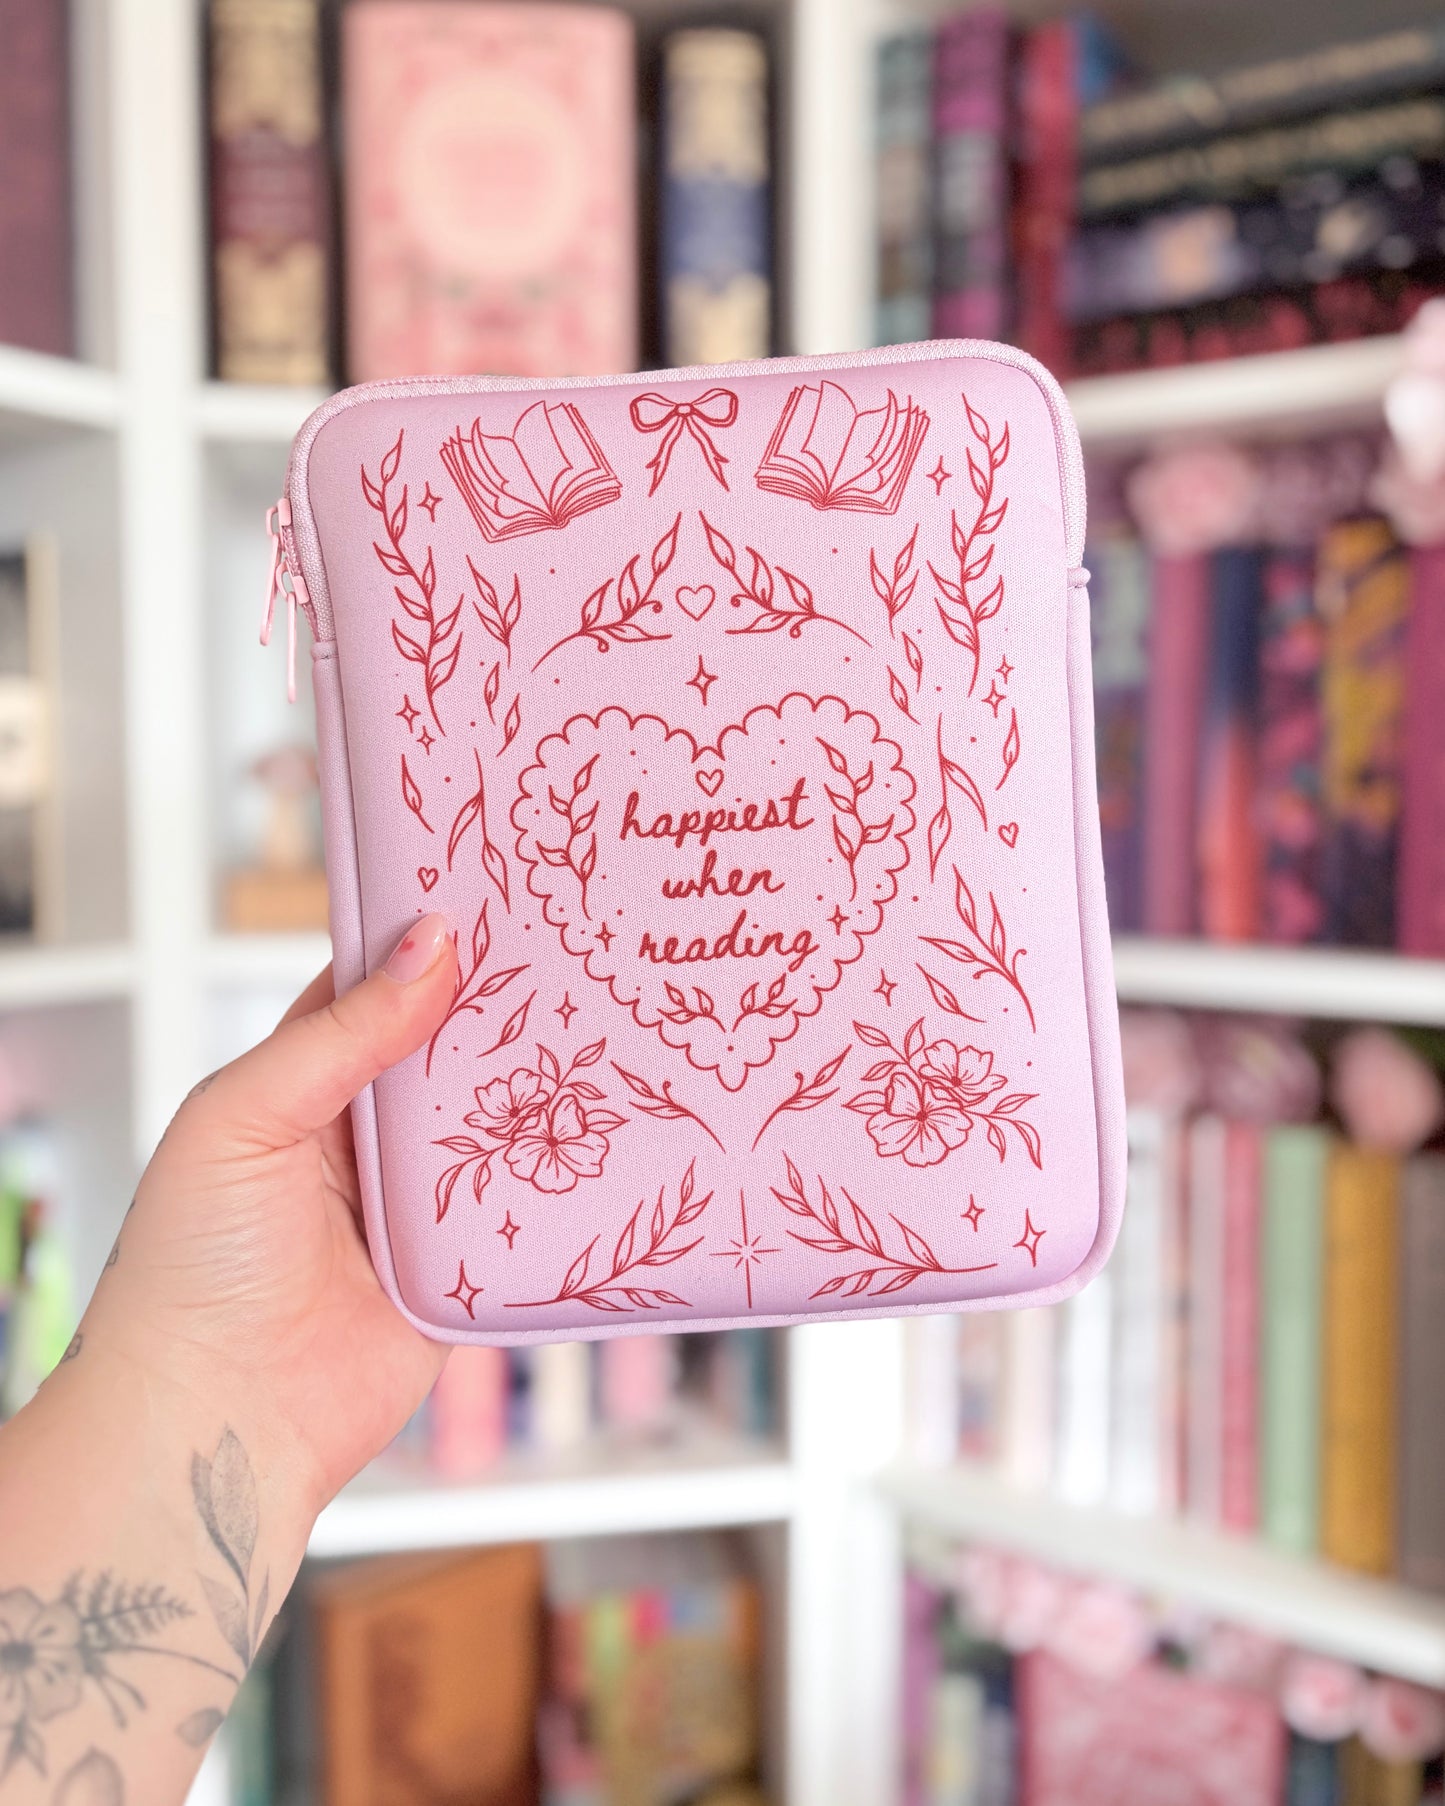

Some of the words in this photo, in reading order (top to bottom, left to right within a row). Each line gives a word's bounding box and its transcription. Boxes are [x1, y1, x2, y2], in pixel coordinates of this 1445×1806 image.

[620, 777, 815, 848] happiest
[662, 850, 785, 899] when
[639, 909, 820, 972] reading
